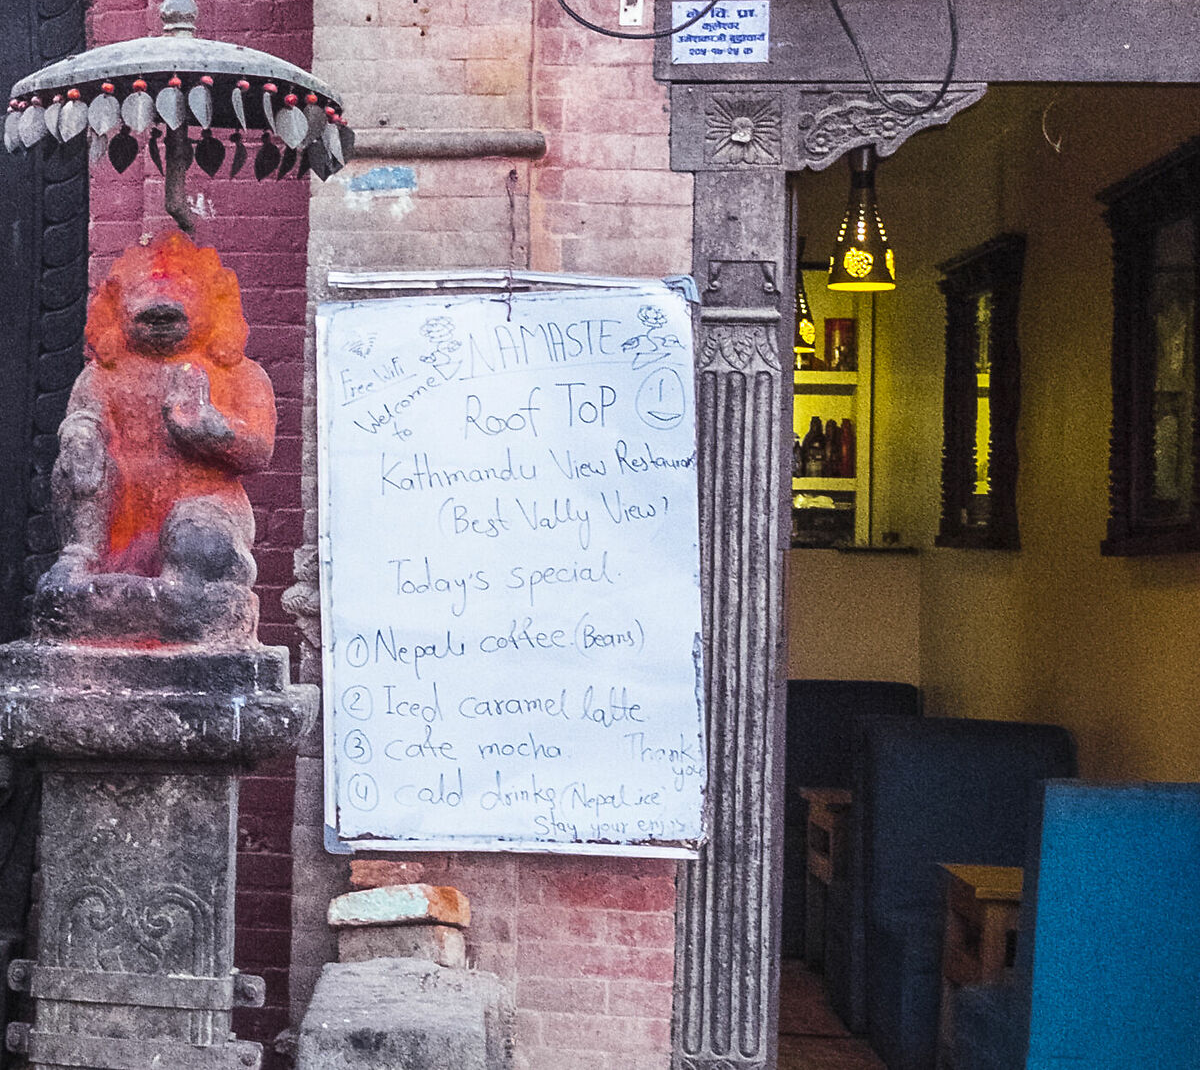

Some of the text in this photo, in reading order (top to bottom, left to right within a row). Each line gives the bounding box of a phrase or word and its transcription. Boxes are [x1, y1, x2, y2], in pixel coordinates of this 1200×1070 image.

[468, 319, 622, 378] NAMASTE
[340, 368, 374, 401] Free
[353, 376, 442, 434] Welcome
[464, 386, 541, 440] Roof
[380, 448, 537, 496] Kathmandu
[549, 448, 607, 480] View
[384, 682, 445, 723] Iced
[458, 688, 570, 721] caramel
